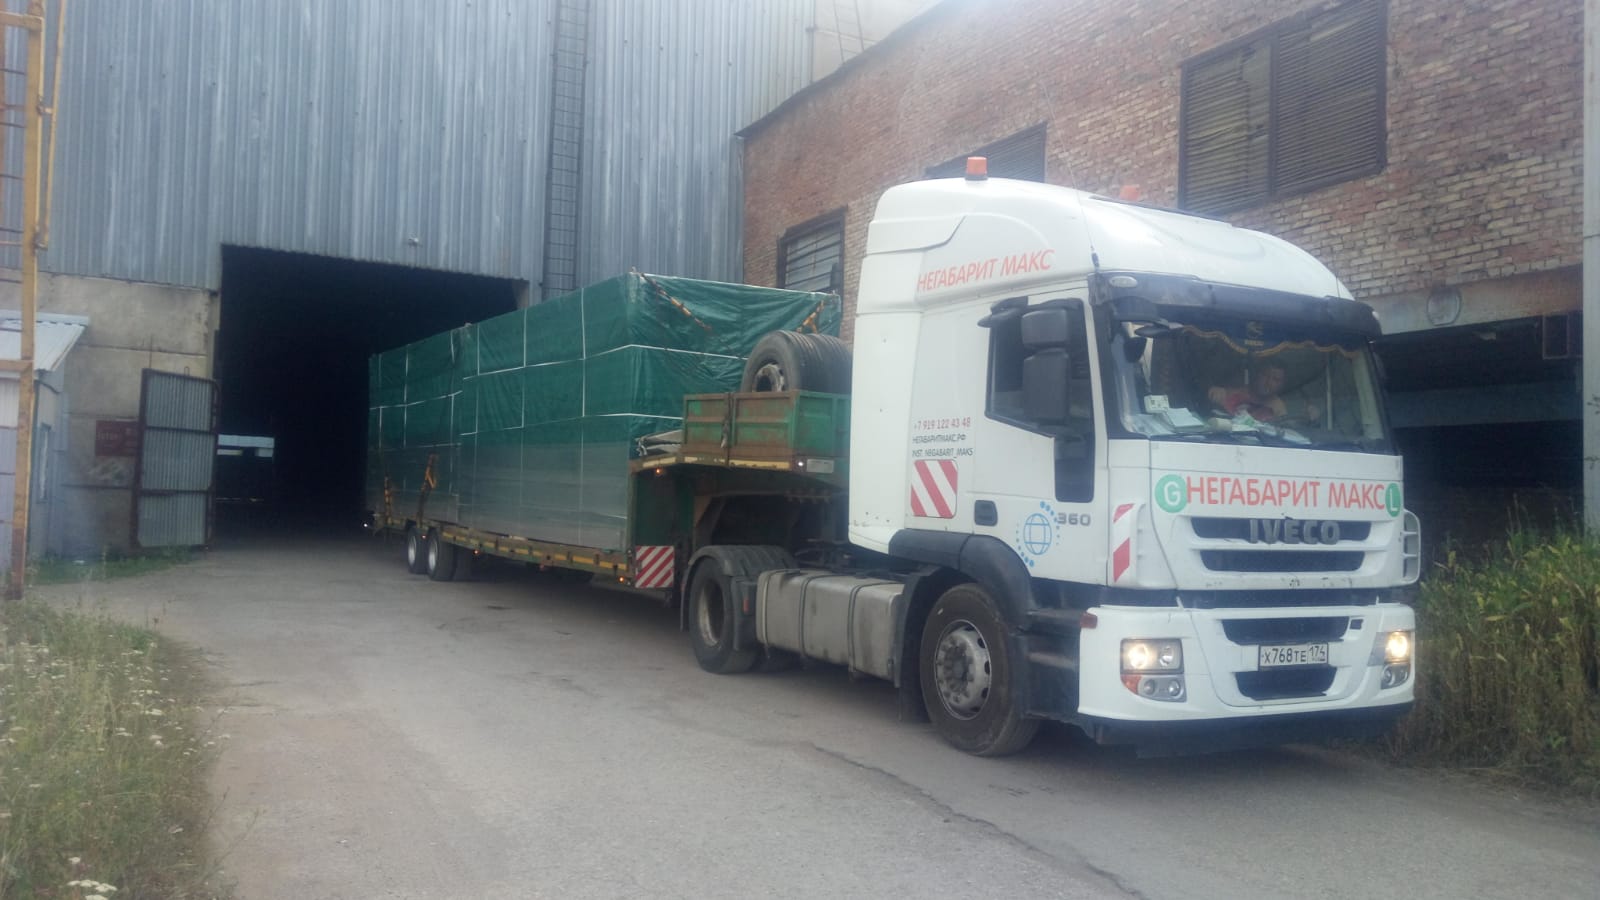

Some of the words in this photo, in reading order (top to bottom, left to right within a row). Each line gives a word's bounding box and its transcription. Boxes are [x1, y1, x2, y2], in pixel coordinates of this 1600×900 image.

[916, 258, 999, 292] НЕГАБАРИТ
[1000, 249, 1055, 277] МАКС
[1186, 476, 1321, 508] НЕГАБАРИТ
[1328, 482, 1385, 510] МАКС
[1057, 512, 1092, 527] 360
[1250, 518, 1341, 546] IVECO
[1309, 645, 1325, 657] 174
